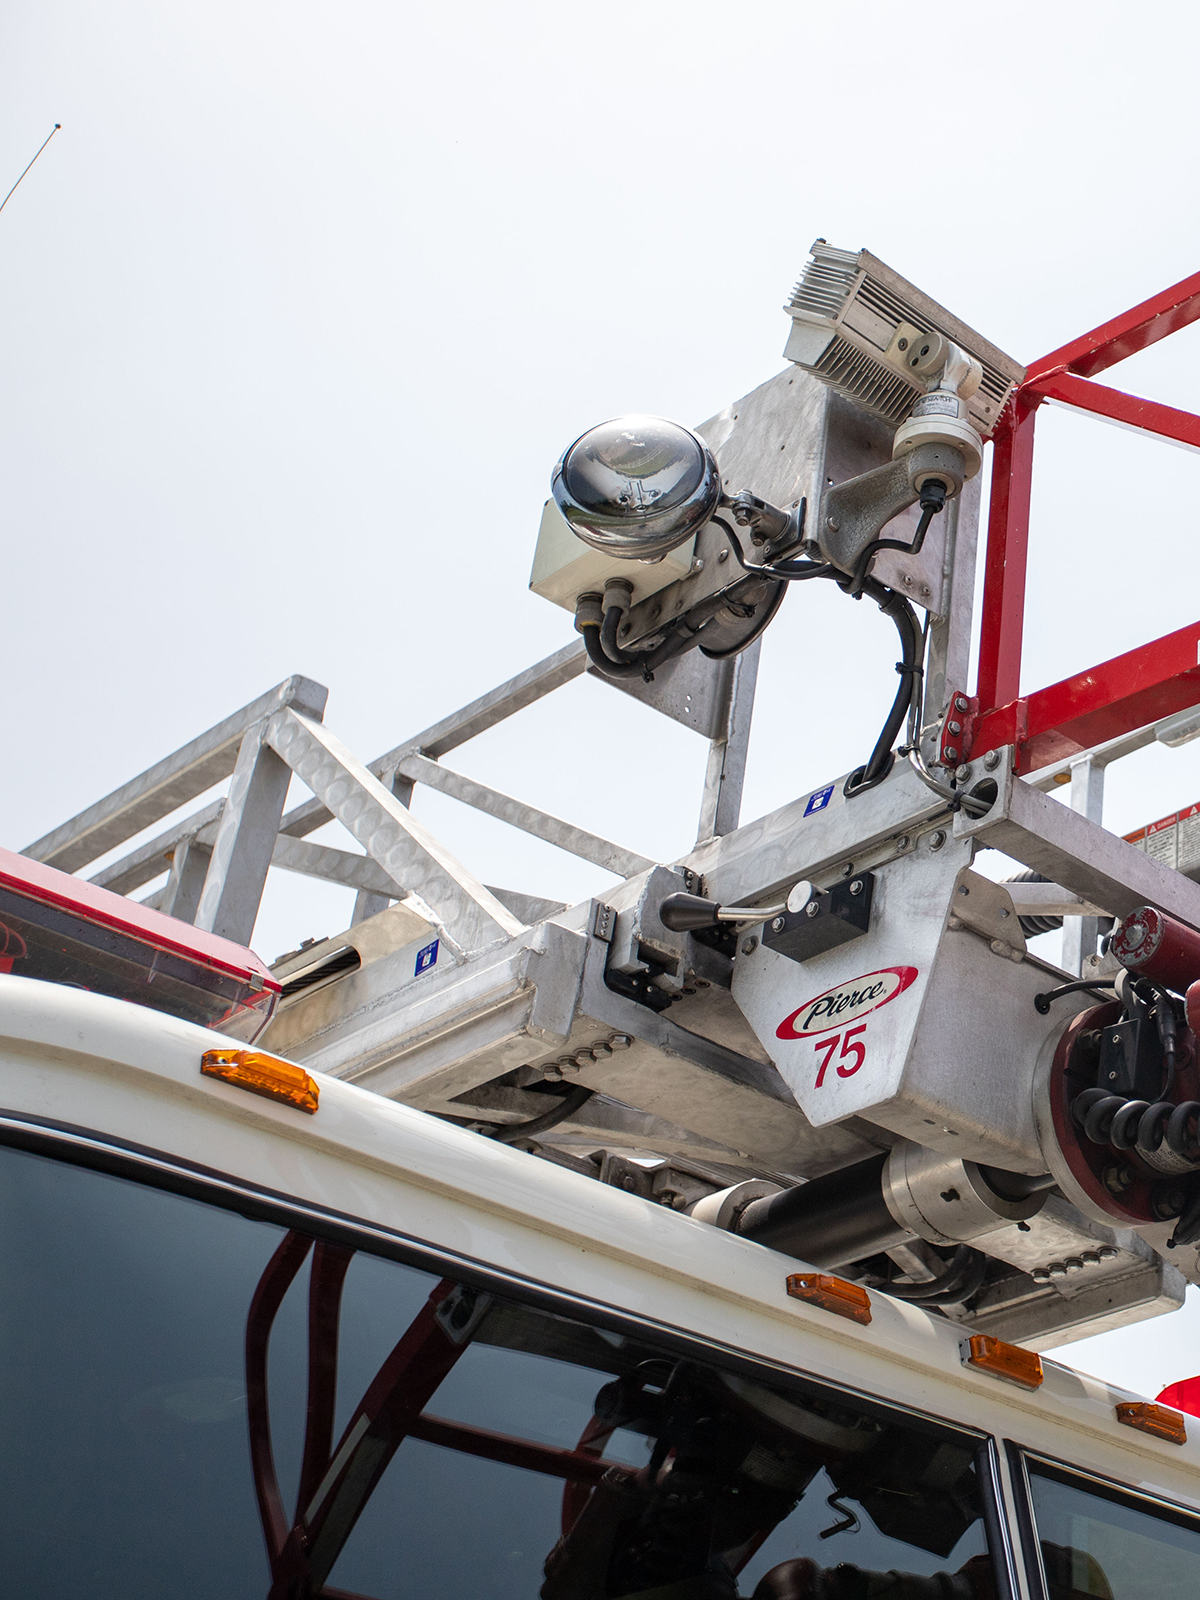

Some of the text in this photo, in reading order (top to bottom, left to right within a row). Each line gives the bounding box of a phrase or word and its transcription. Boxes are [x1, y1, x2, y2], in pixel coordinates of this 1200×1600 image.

[1156, 815, 1177, 830] DANGER
[802, 980, 884, 1030] Pierce
[813, 1022, 868, 1090] 75
